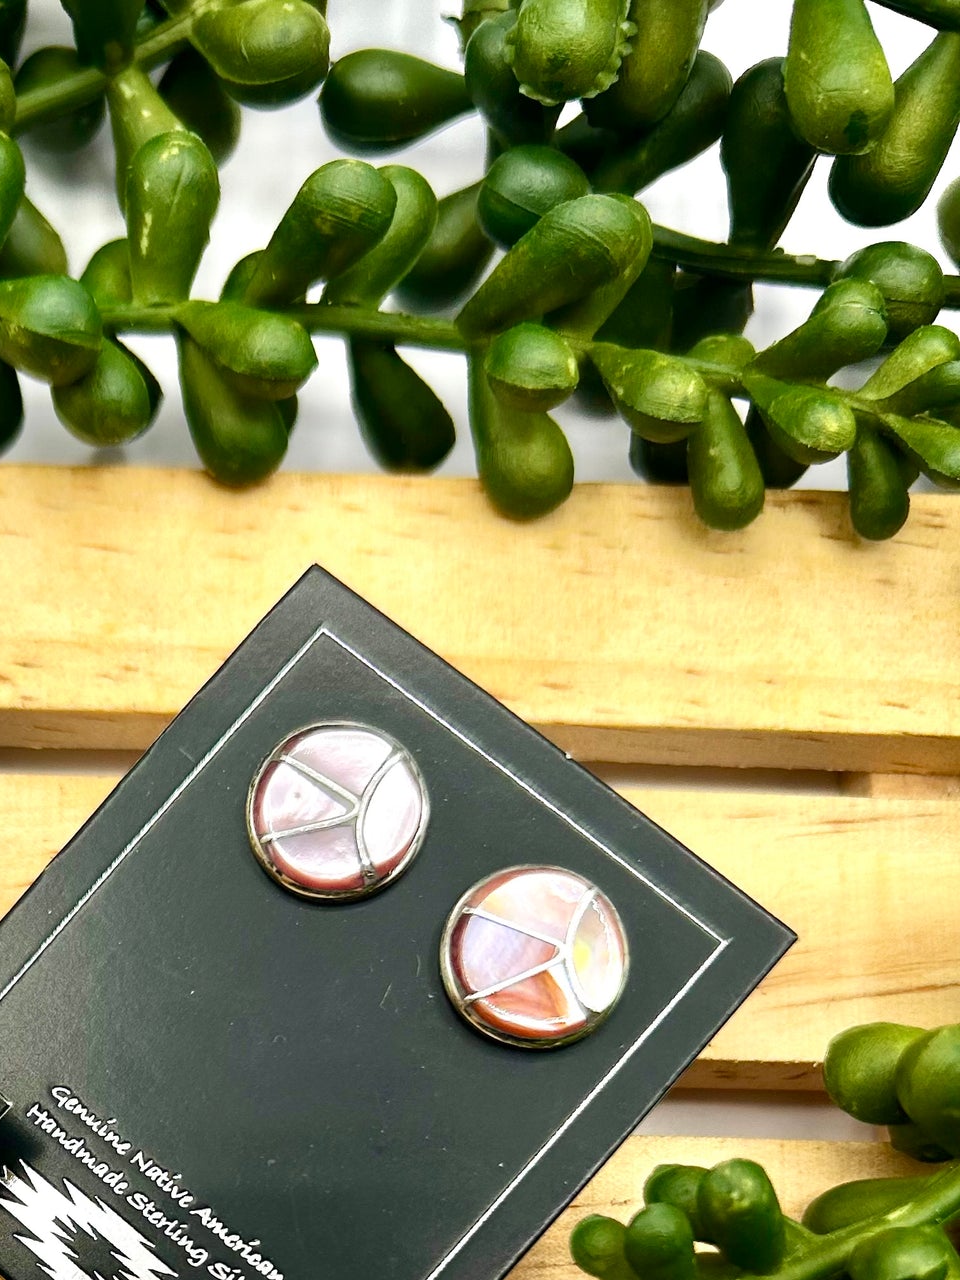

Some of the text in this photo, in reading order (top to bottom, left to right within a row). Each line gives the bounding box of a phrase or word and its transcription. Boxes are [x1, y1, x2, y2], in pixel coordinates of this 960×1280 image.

[26, 1102, 127, 1195] Handmade
[126, 1194, 210, 1267] Sterling
[50, 1085, 132, 1155] Genuine
[130, 1150, 195, 1207] Native
